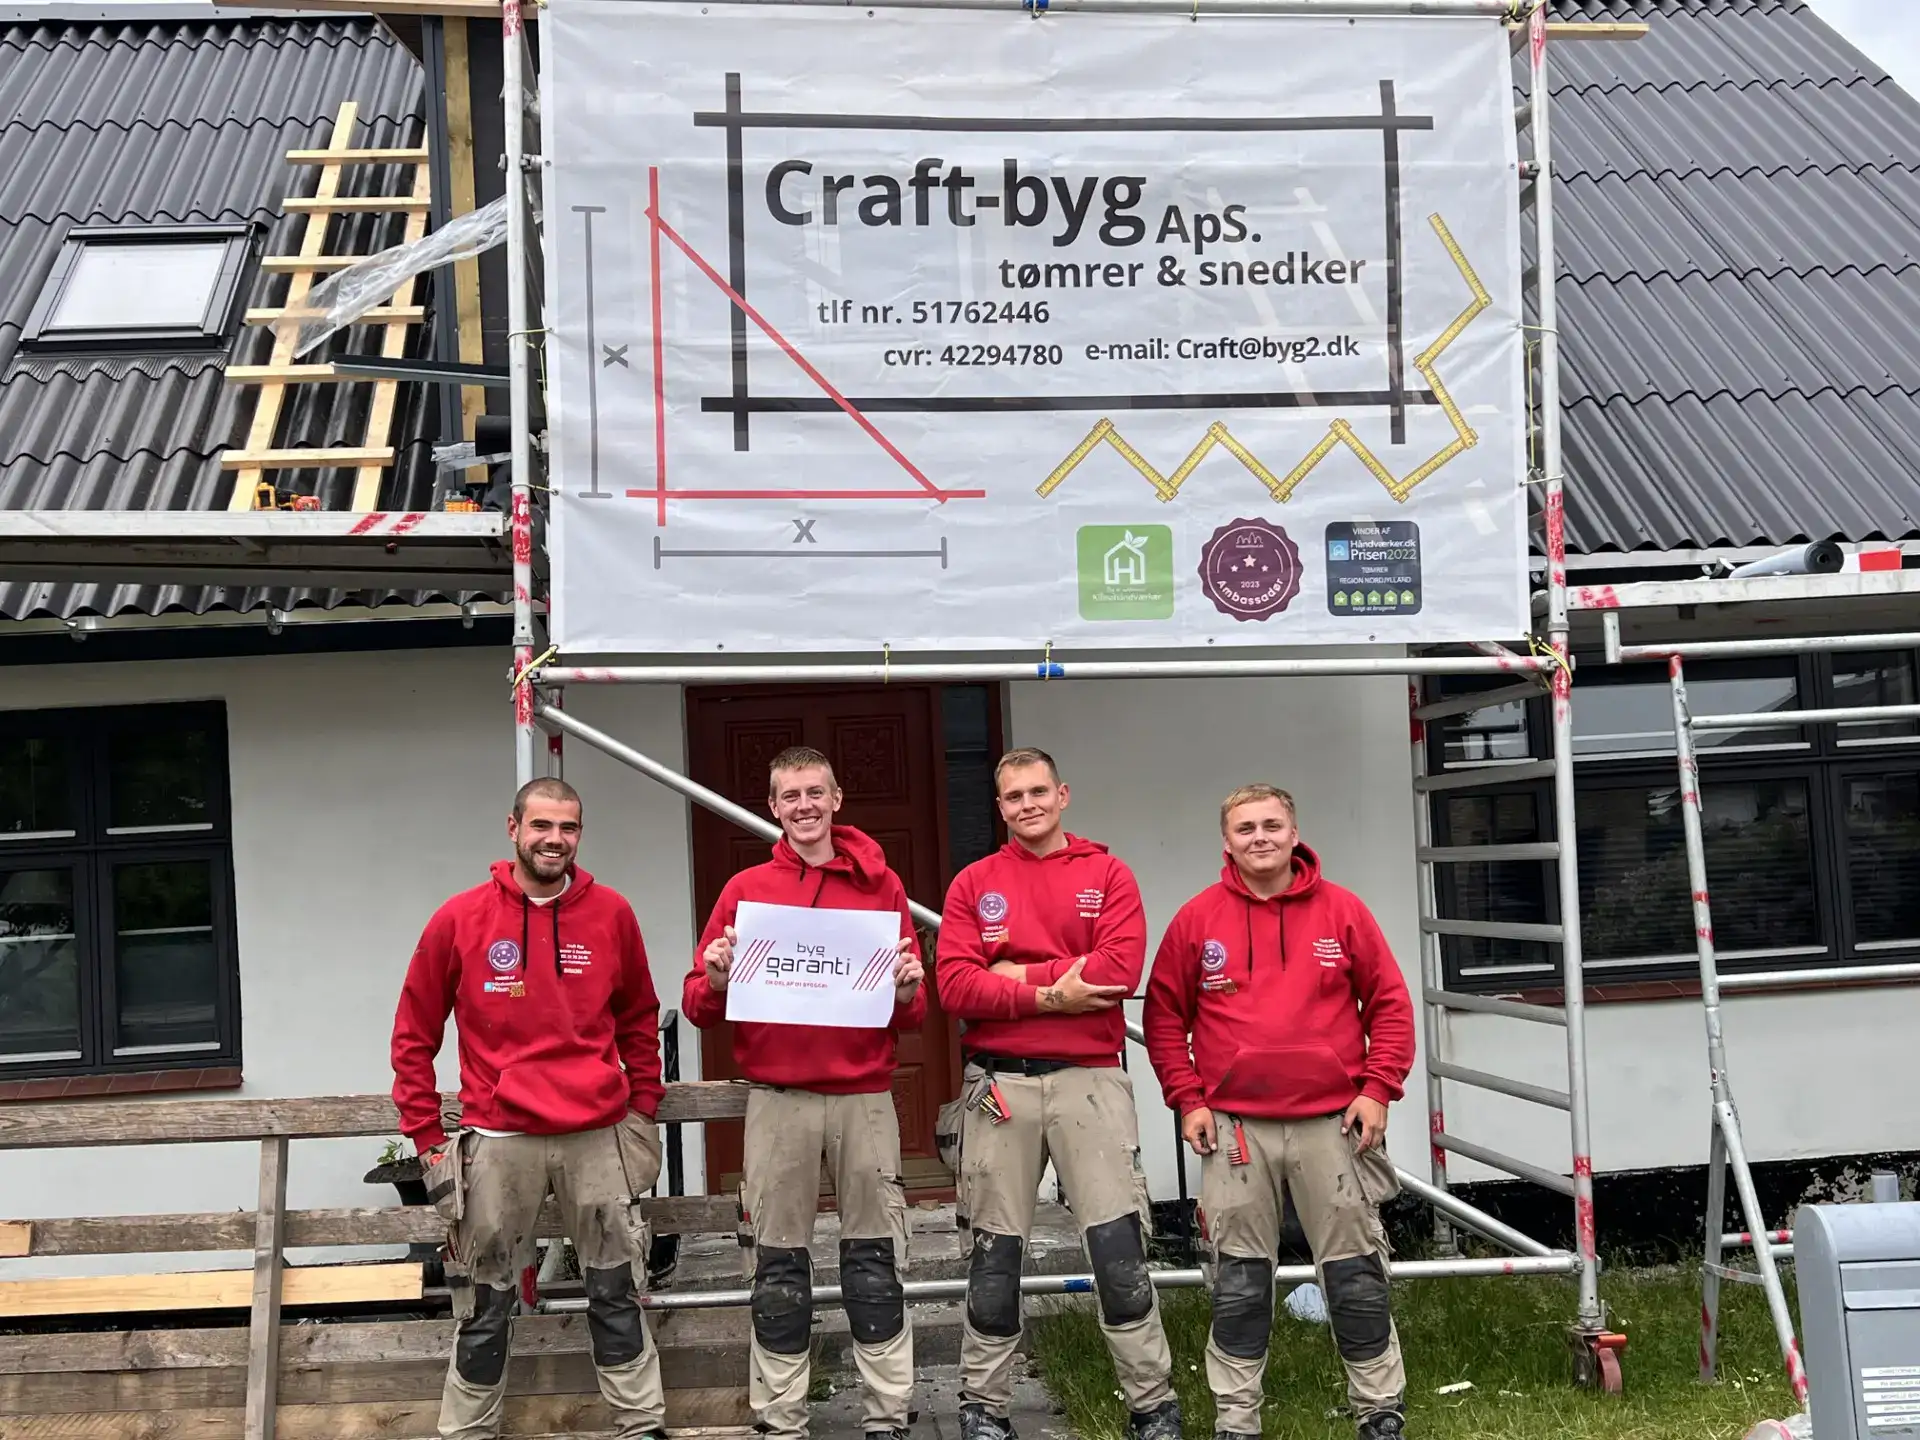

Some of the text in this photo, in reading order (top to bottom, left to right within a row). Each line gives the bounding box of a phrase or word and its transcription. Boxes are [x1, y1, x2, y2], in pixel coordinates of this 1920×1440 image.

[765, 157, 1262, 256] Craft-byg ApS.
[998, 251, 1366, 290] tømrer & snedker
[818, 299, 1051, 325] tlf nr. 51762446
[884, 344, 1063, 366] cvr: 42294780
[1085, 335, 1361, 364] e-mail: Craft@byg2.dk
[1352, 527, 1391, 535] VINDER AF
[1350, 540, 1417, 549] Håndværker.dk
[1240, 580, 1261, 589] 2023
[797, 942, 826, 958] byg
[766, 956, 852, 978] garanti
